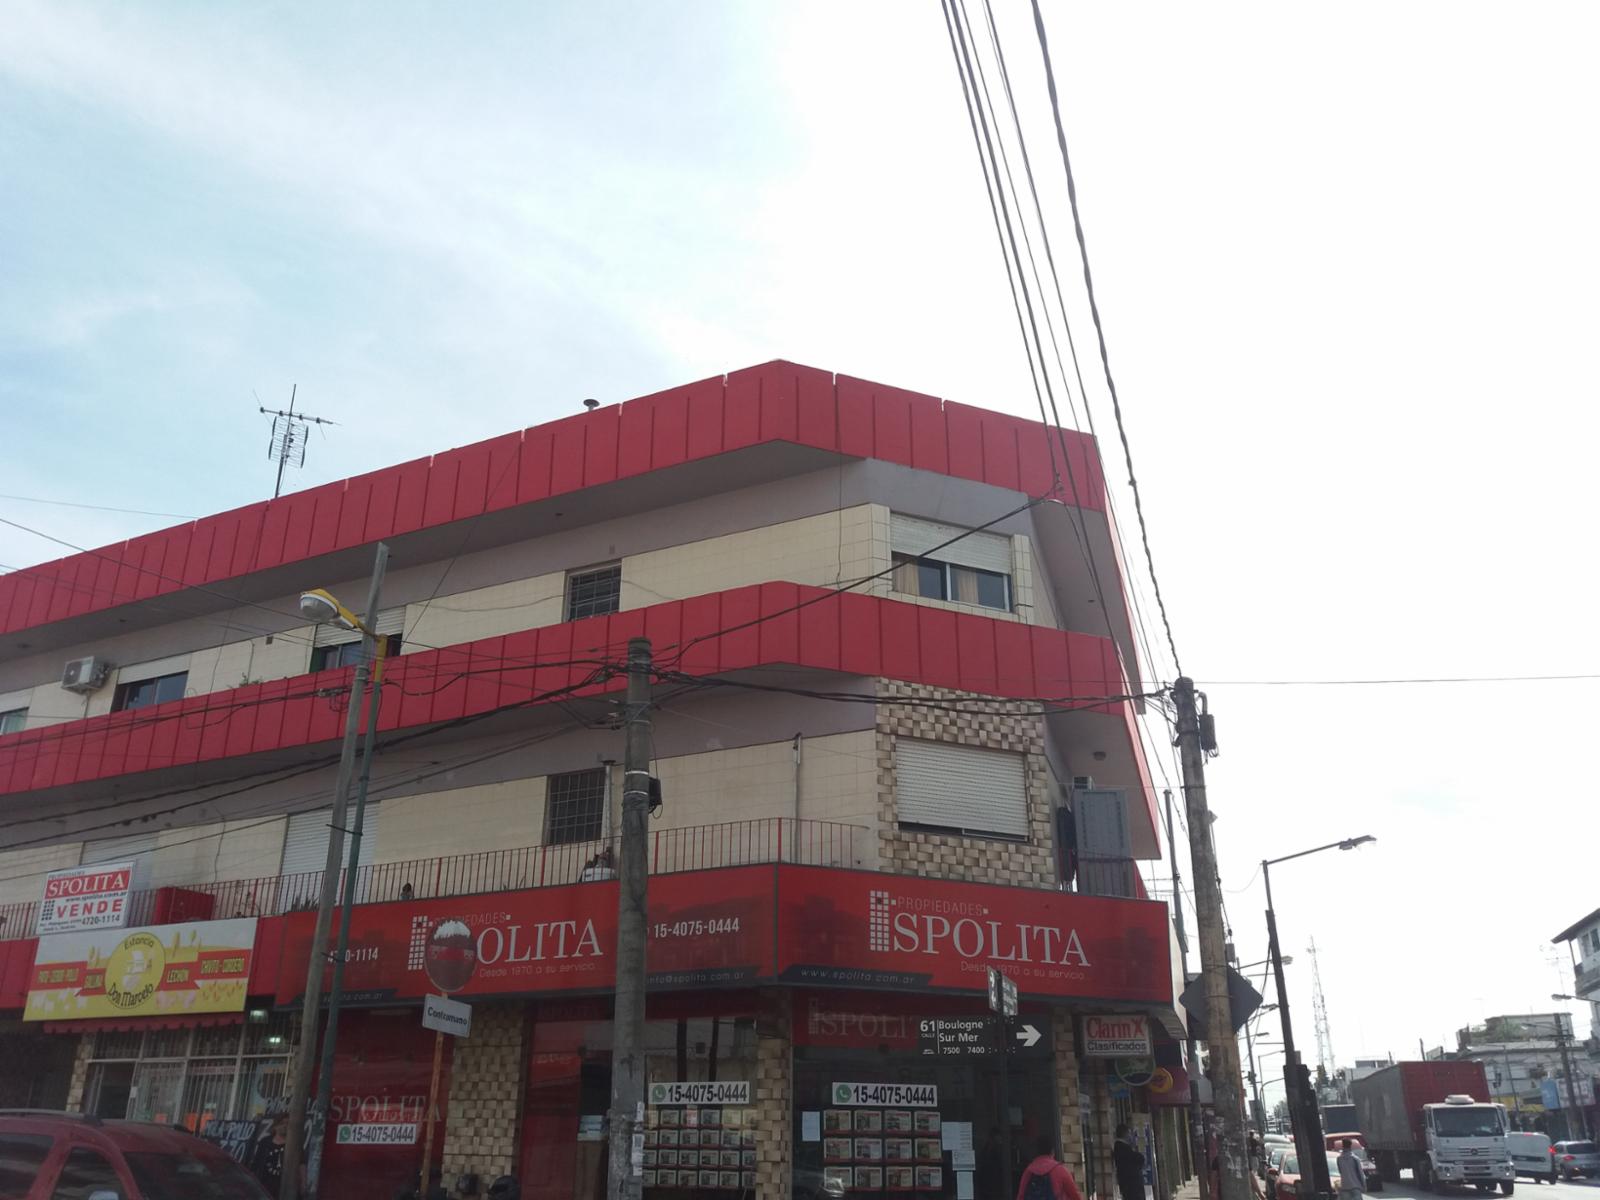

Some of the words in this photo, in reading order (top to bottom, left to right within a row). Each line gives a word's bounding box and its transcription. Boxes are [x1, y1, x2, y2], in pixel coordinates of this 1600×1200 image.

[47, 873, 125, 898] SPOLITA
[57, 898, 123, 919] VENDE
[897, 896, 983, 916] PROPIEDADES
[82, 914, 121, 926] 4720-1114
[654, 917, 740, 939] 15-4075-0444
[476, 918, 604, 965] OLITA
[893, 912, 1091, 967] SPOLITA
[800, 968, 915, 985] www.spolita.com.ar
[427, 1006, 468, 1026] Contramano
[920, 1020, 935, 1032] 61
[938, 1020, 983, 1032] Boulogne
[939, 1032, 956, 1042] Sur
[957, 1032, 978, 1042] Mer
[1087, 1041, 1146, 1051] Clasificados
[943, 1046, 961, 1055] 7500
[967, 1046, 985, 1054] 7400
[667, 1083, 748, 1103] 15-4075-0444
[853, 1085, 936, 1105] 15-4075-0444
[352, 1126, 414, 1142] 15-4075-0444
